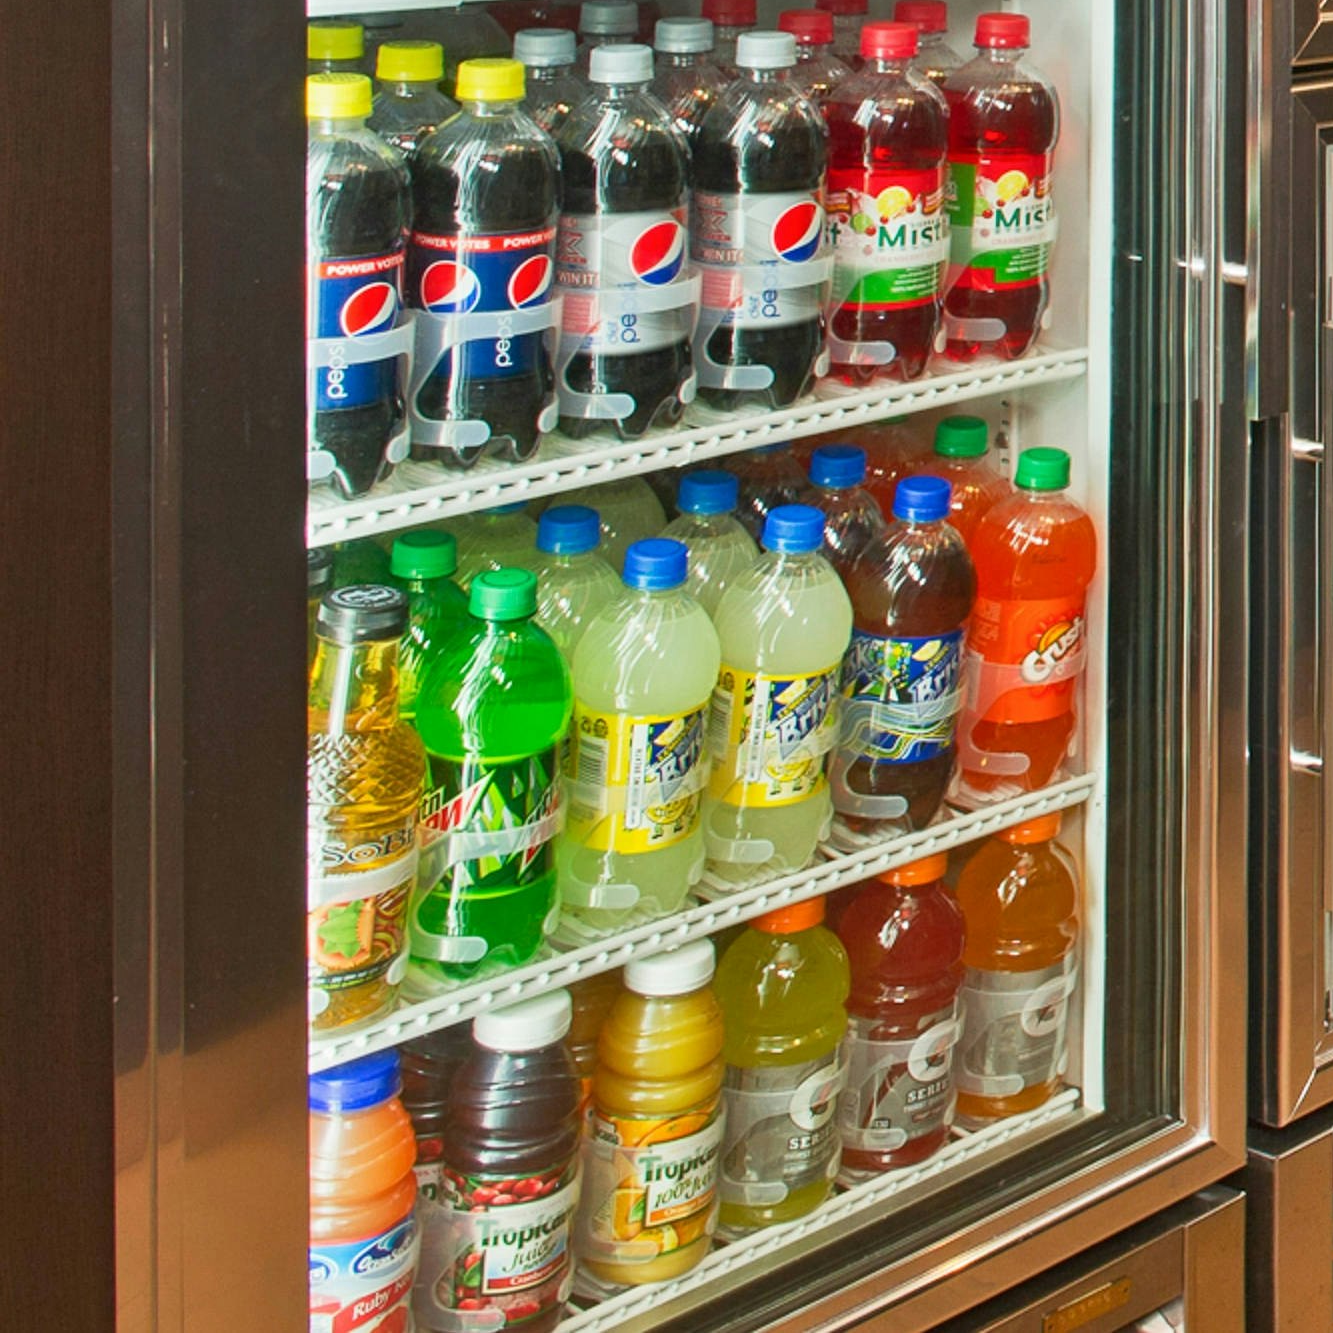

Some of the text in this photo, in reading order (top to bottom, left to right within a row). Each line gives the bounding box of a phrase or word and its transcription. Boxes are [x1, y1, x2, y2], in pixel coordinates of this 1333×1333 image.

[414, 233, 492, 251] POWER VOTES
[502, 233, 544, 249] POWER
[325, 260, 376, 278] POWER
[495, 312, 514, 368] pepsi
[327, 343, 348, 400] pepsi
[1020, 616, 1085, 683] Crush
[351, 1285, 392, 1322] Ruby
